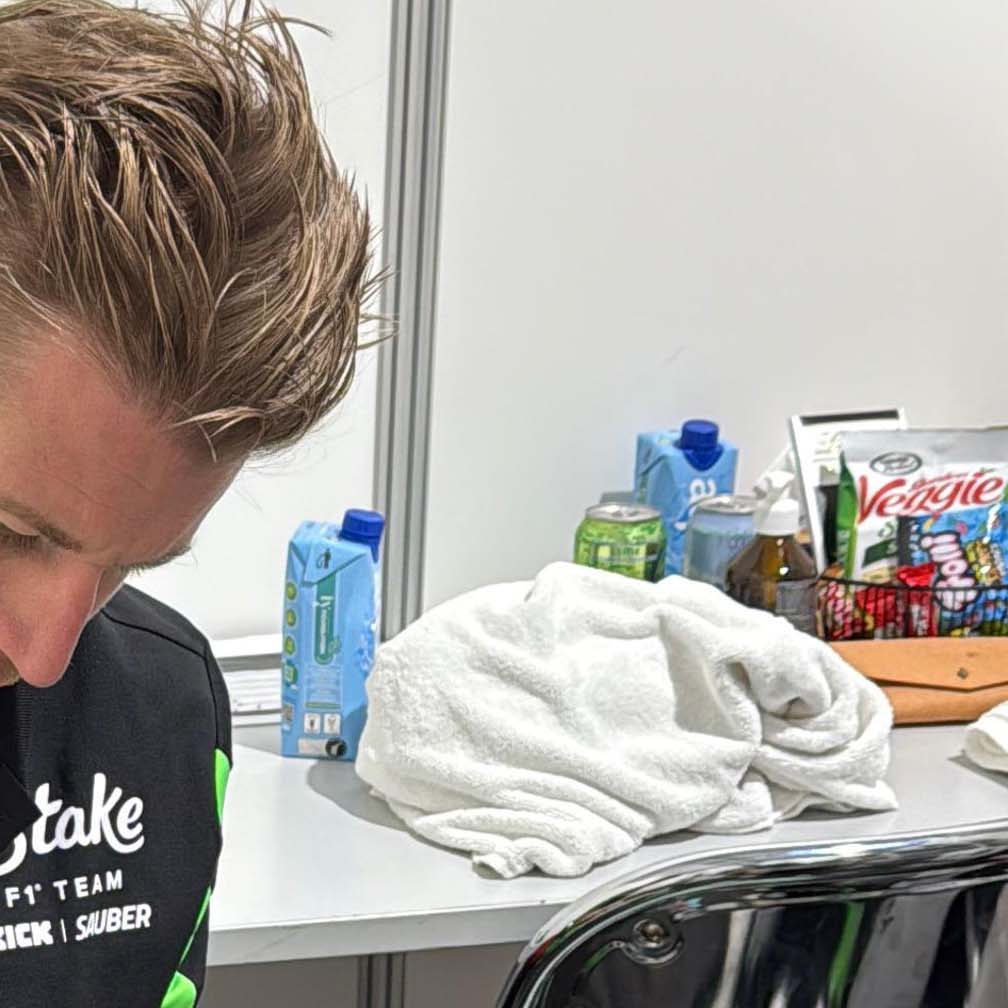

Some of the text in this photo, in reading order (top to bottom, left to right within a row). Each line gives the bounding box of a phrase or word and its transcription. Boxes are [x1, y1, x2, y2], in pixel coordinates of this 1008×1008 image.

[856, 474, 1004, 525] Veggie
[52, 869, 123, 901] TEAM
[75, 903, 152, 941] SAUBER
